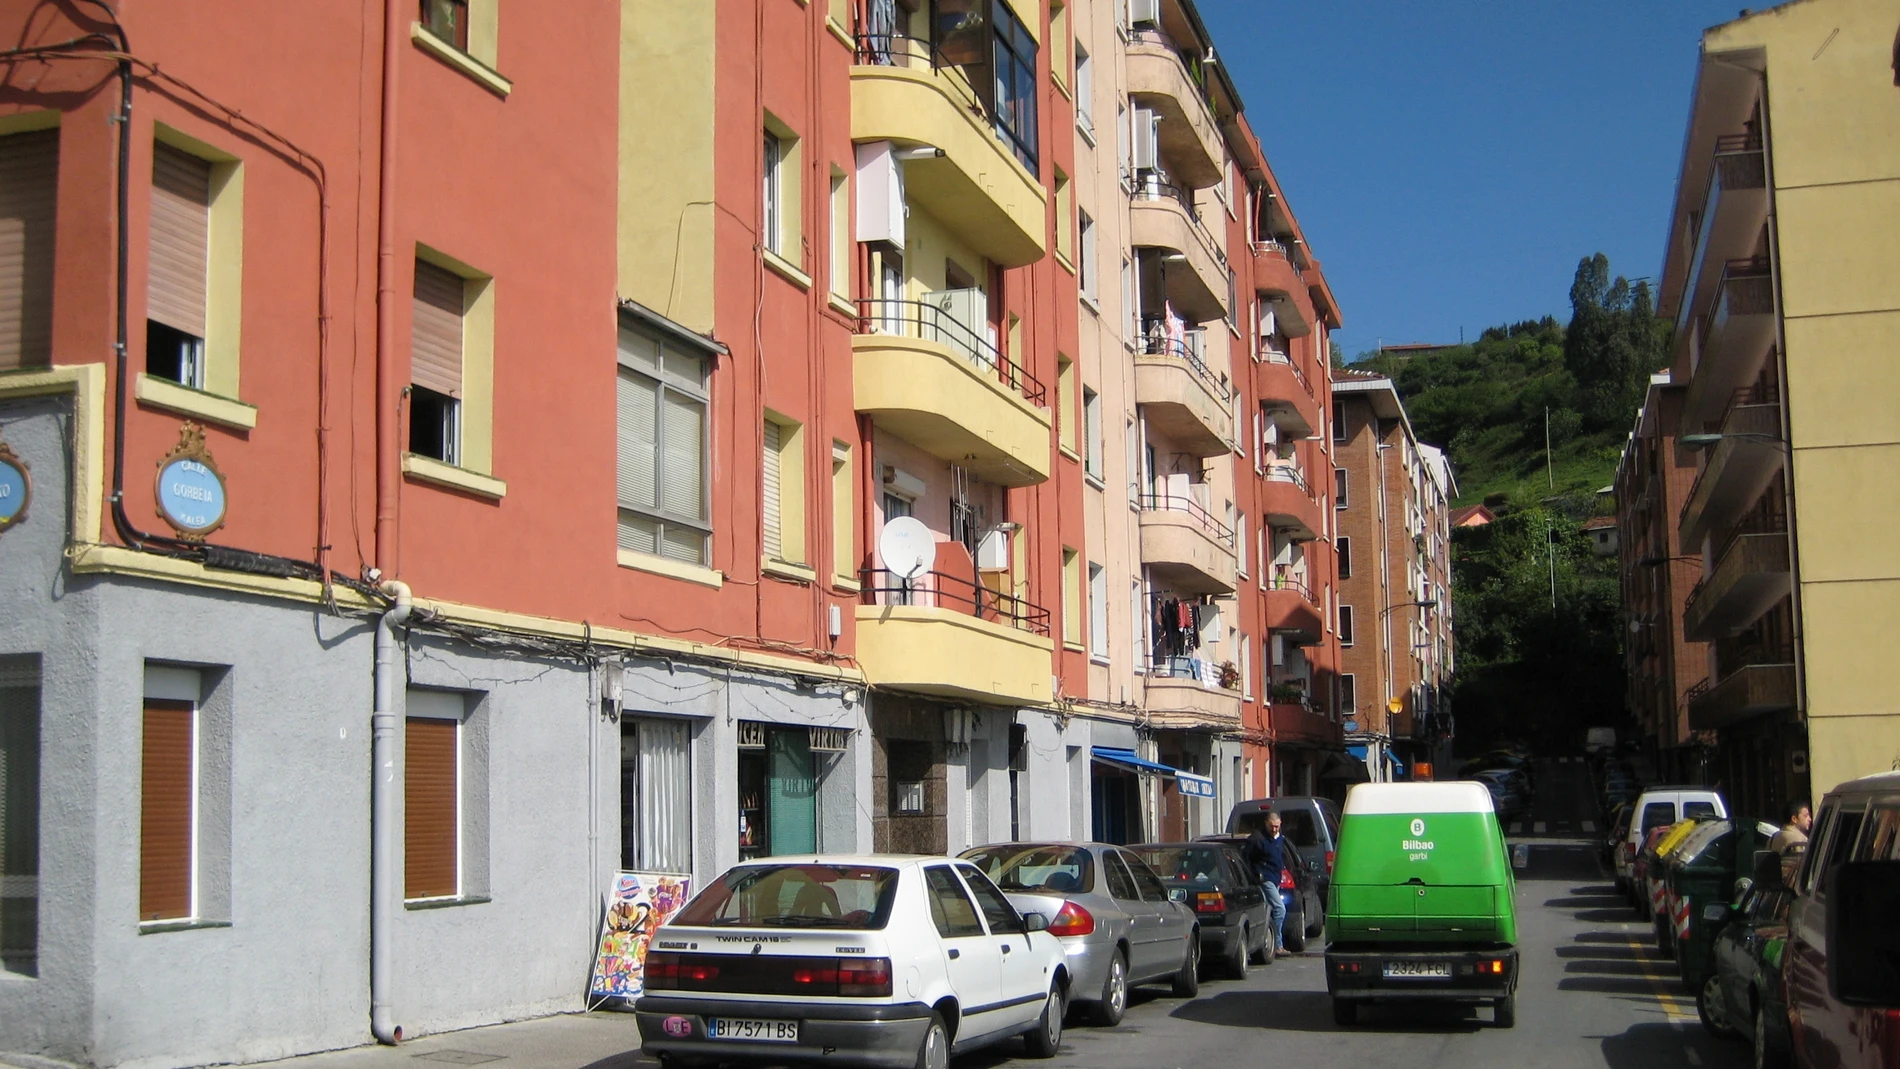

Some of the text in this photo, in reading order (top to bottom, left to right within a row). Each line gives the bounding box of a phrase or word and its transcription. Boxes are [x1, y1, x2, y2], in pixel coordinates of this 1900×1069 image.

[181, 460, 208, 475] CALLE
[173, 483, 212, 502] GORBEIA
[808, 726, 845, 749] VIRTUS
[1402, 840, 1434, 851] Bilbao
[1409, 852, 1428, 861] garbi
[1392, 962, 1422, 976] 2324
[717, 1020, 796, 1039] BI 7571 BS
